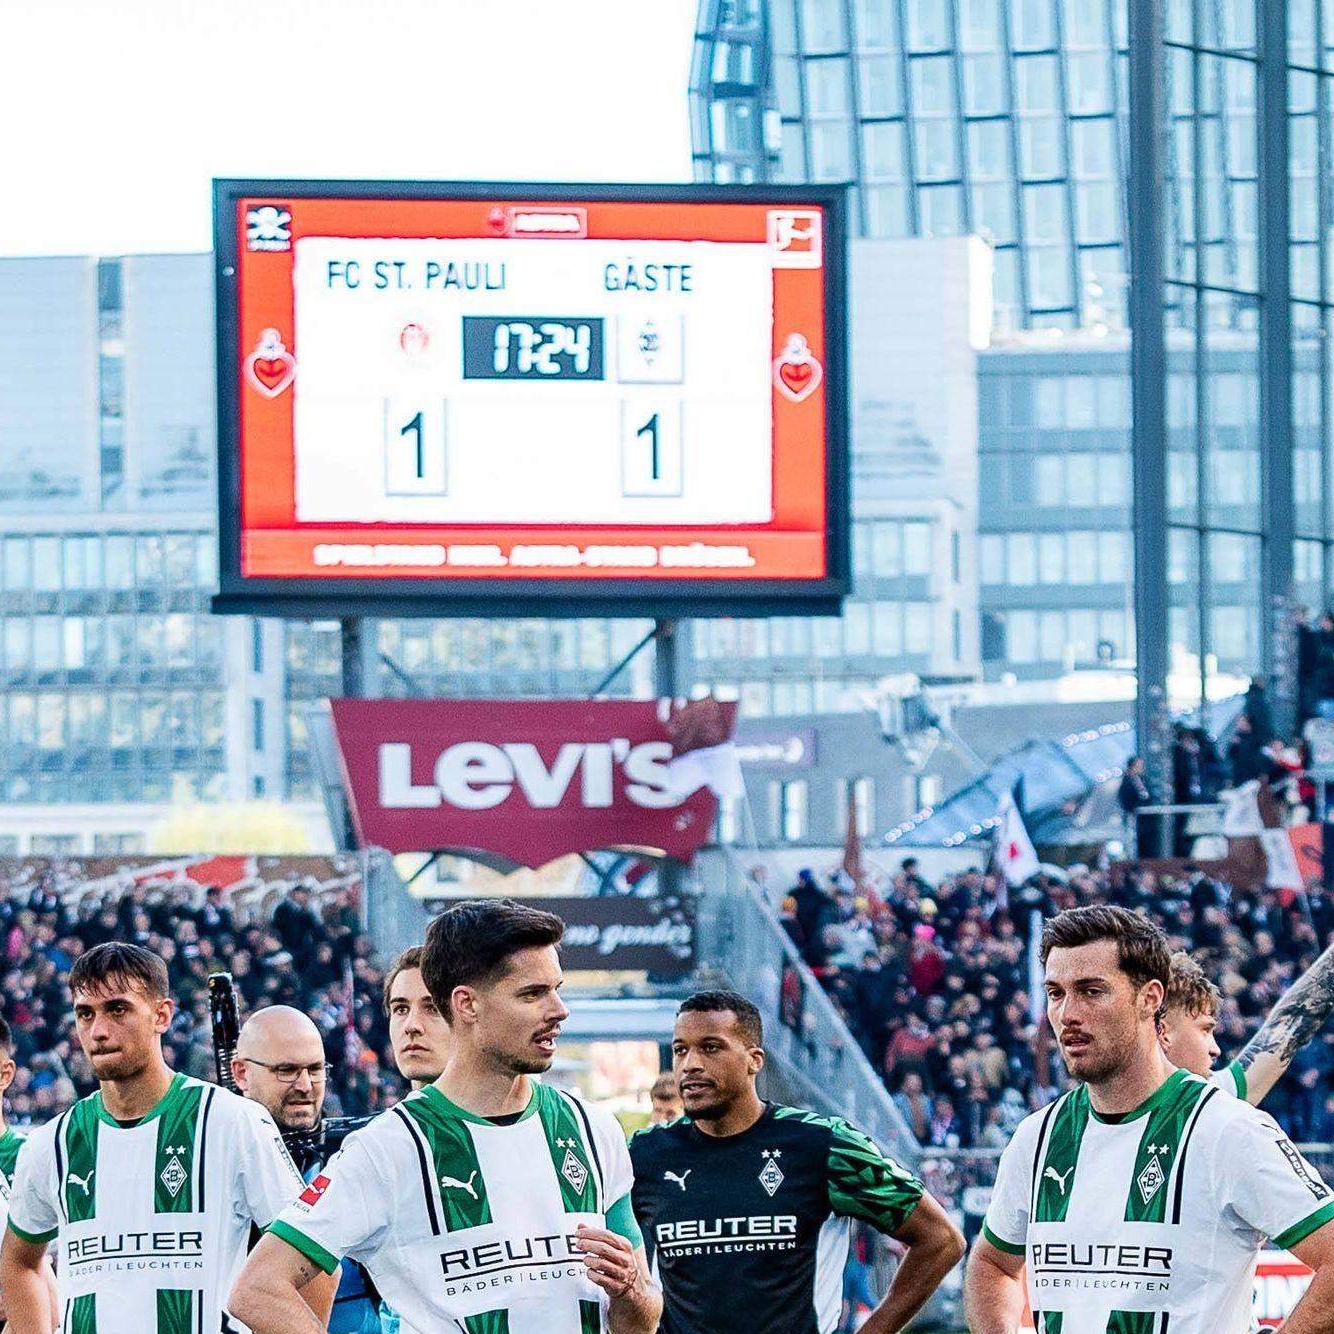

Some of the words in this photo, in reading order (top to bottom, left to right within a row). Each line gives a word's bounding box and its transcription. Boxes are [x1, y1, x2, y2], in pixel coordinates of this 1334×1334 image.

[327, 260, 361, 290] FC
[374, 260, 413, 290] ST.
[426, 261, 506, 291] PAULI
[604, 255, 694, 292] GÄSTE
[493, 323, 593, 375] 17:24
[400, 411, 425, 480] 1
[637, 412, 661, 481] 1
[656, 1214, 798, 1243] REUTER
[68, 1231, 203, 1260] REUTER
[439, 1234, 589, 1275] REUTE
[714, 1240, 797, 1255] LEUCHTEN
[1032, 1243, 1174, 1271] REUTER
[116, 1260, 204, 1272] LEUCHTEN
[446, 1273, 515, 1297] BÄDER
[1083, 1279, 1171, 1293] LEUCHTEN
